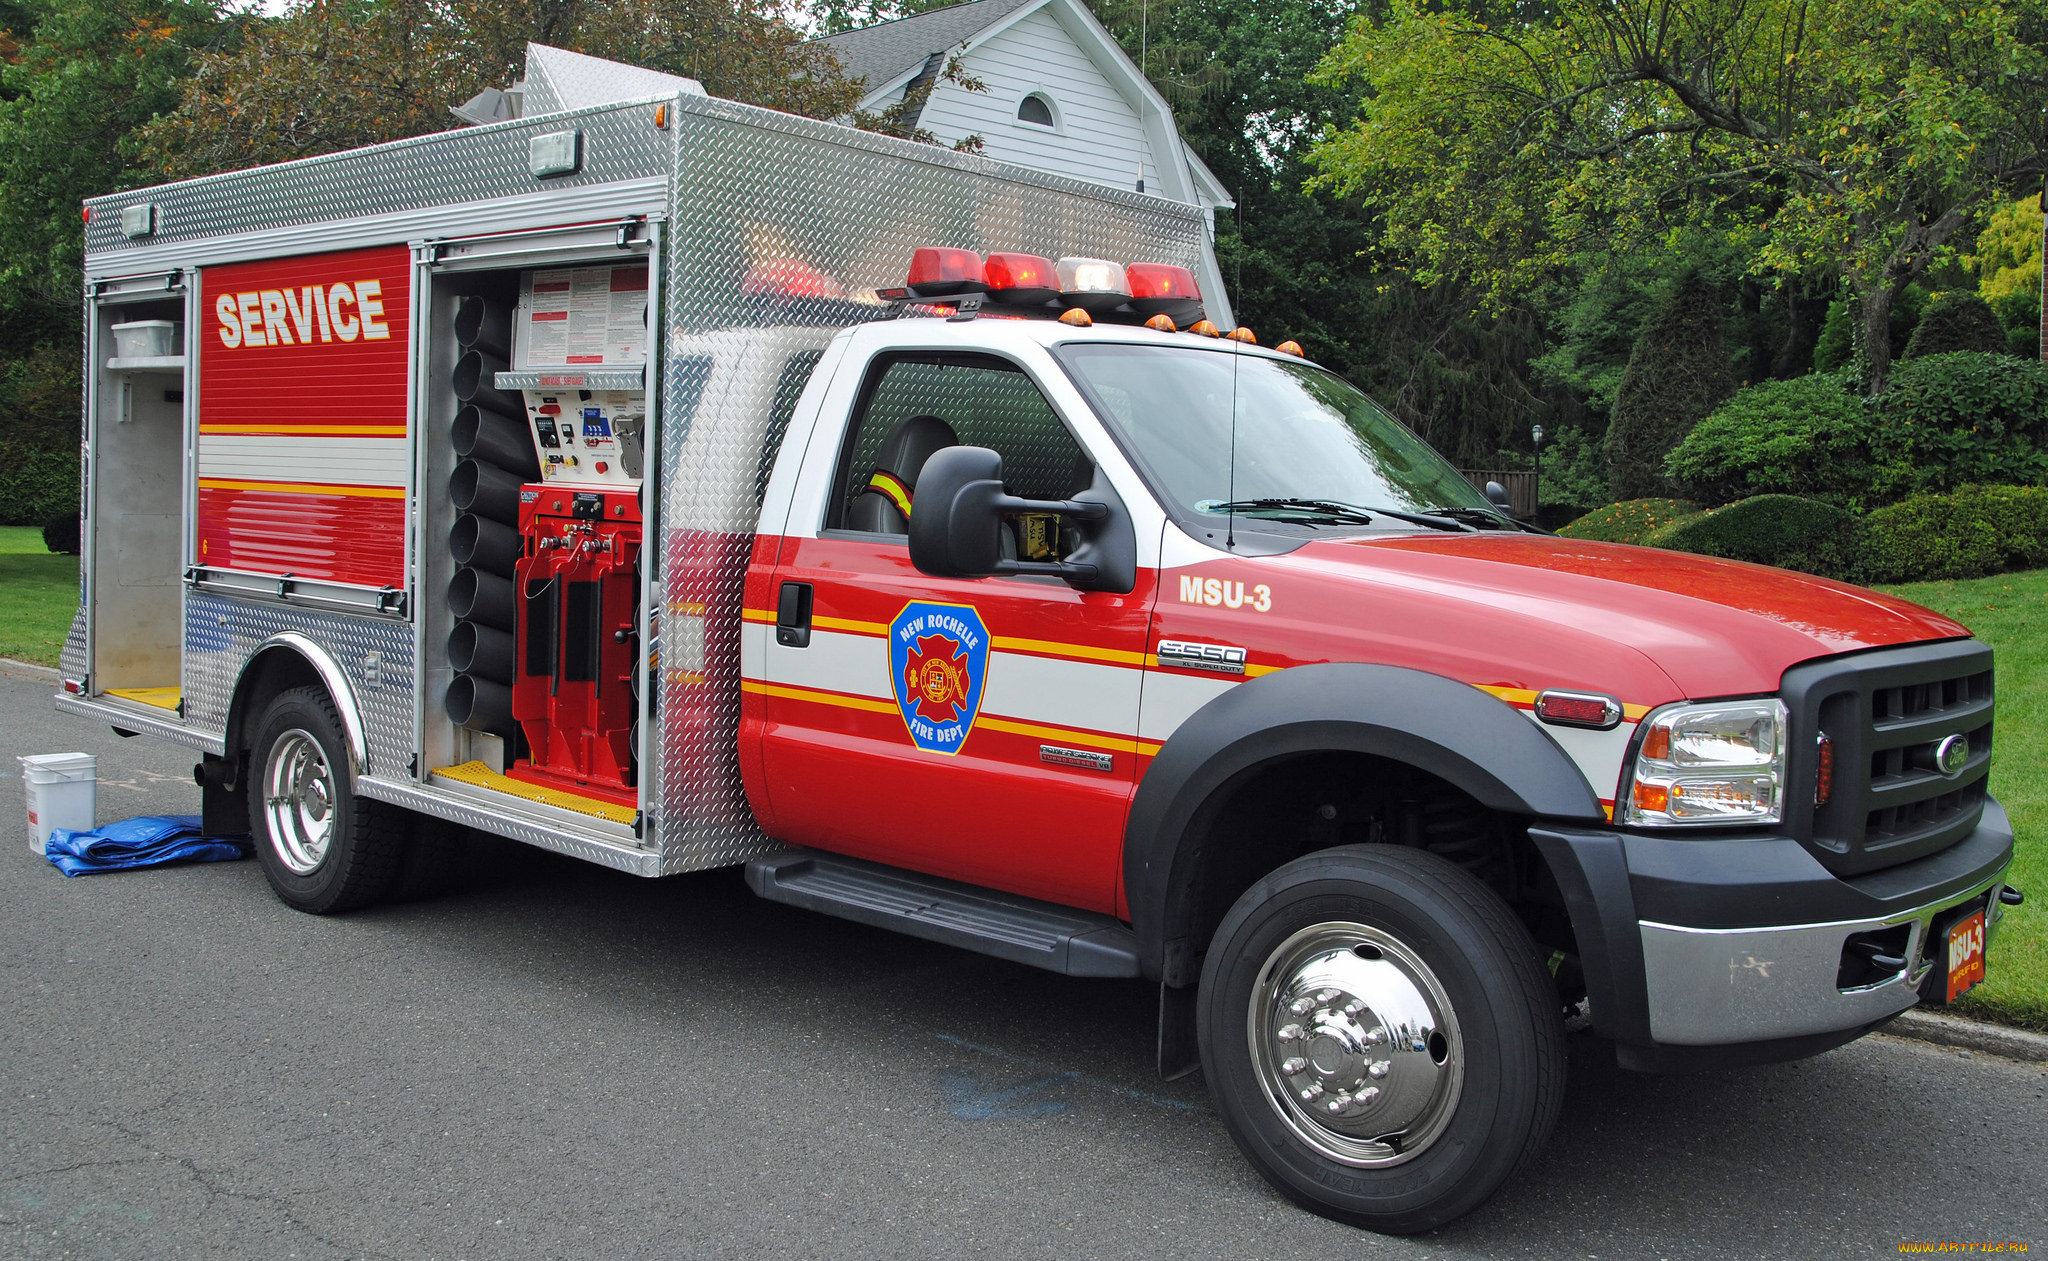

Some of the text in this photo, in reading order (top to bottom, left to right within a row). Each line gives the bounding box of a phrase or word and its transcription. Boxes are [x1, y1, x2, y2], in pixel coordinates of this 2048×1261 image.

[216, 279, 391, 349] SERVICE
[202, 538, 209, 555] 6
[1179, 574, 1272, 613] MSU-3
[899, 614, 979, 650] NEW ROCHELLE
[1194, 662, 1219, 670] SUPER
[1220, 665, 1242, 673] DUTY
[910, 717, 964, 742] FIRE DEPT
[1042, 754, 1110, 770] TURBO DIESEL V8
[1948, 924, 1984, 974] MSU-3
